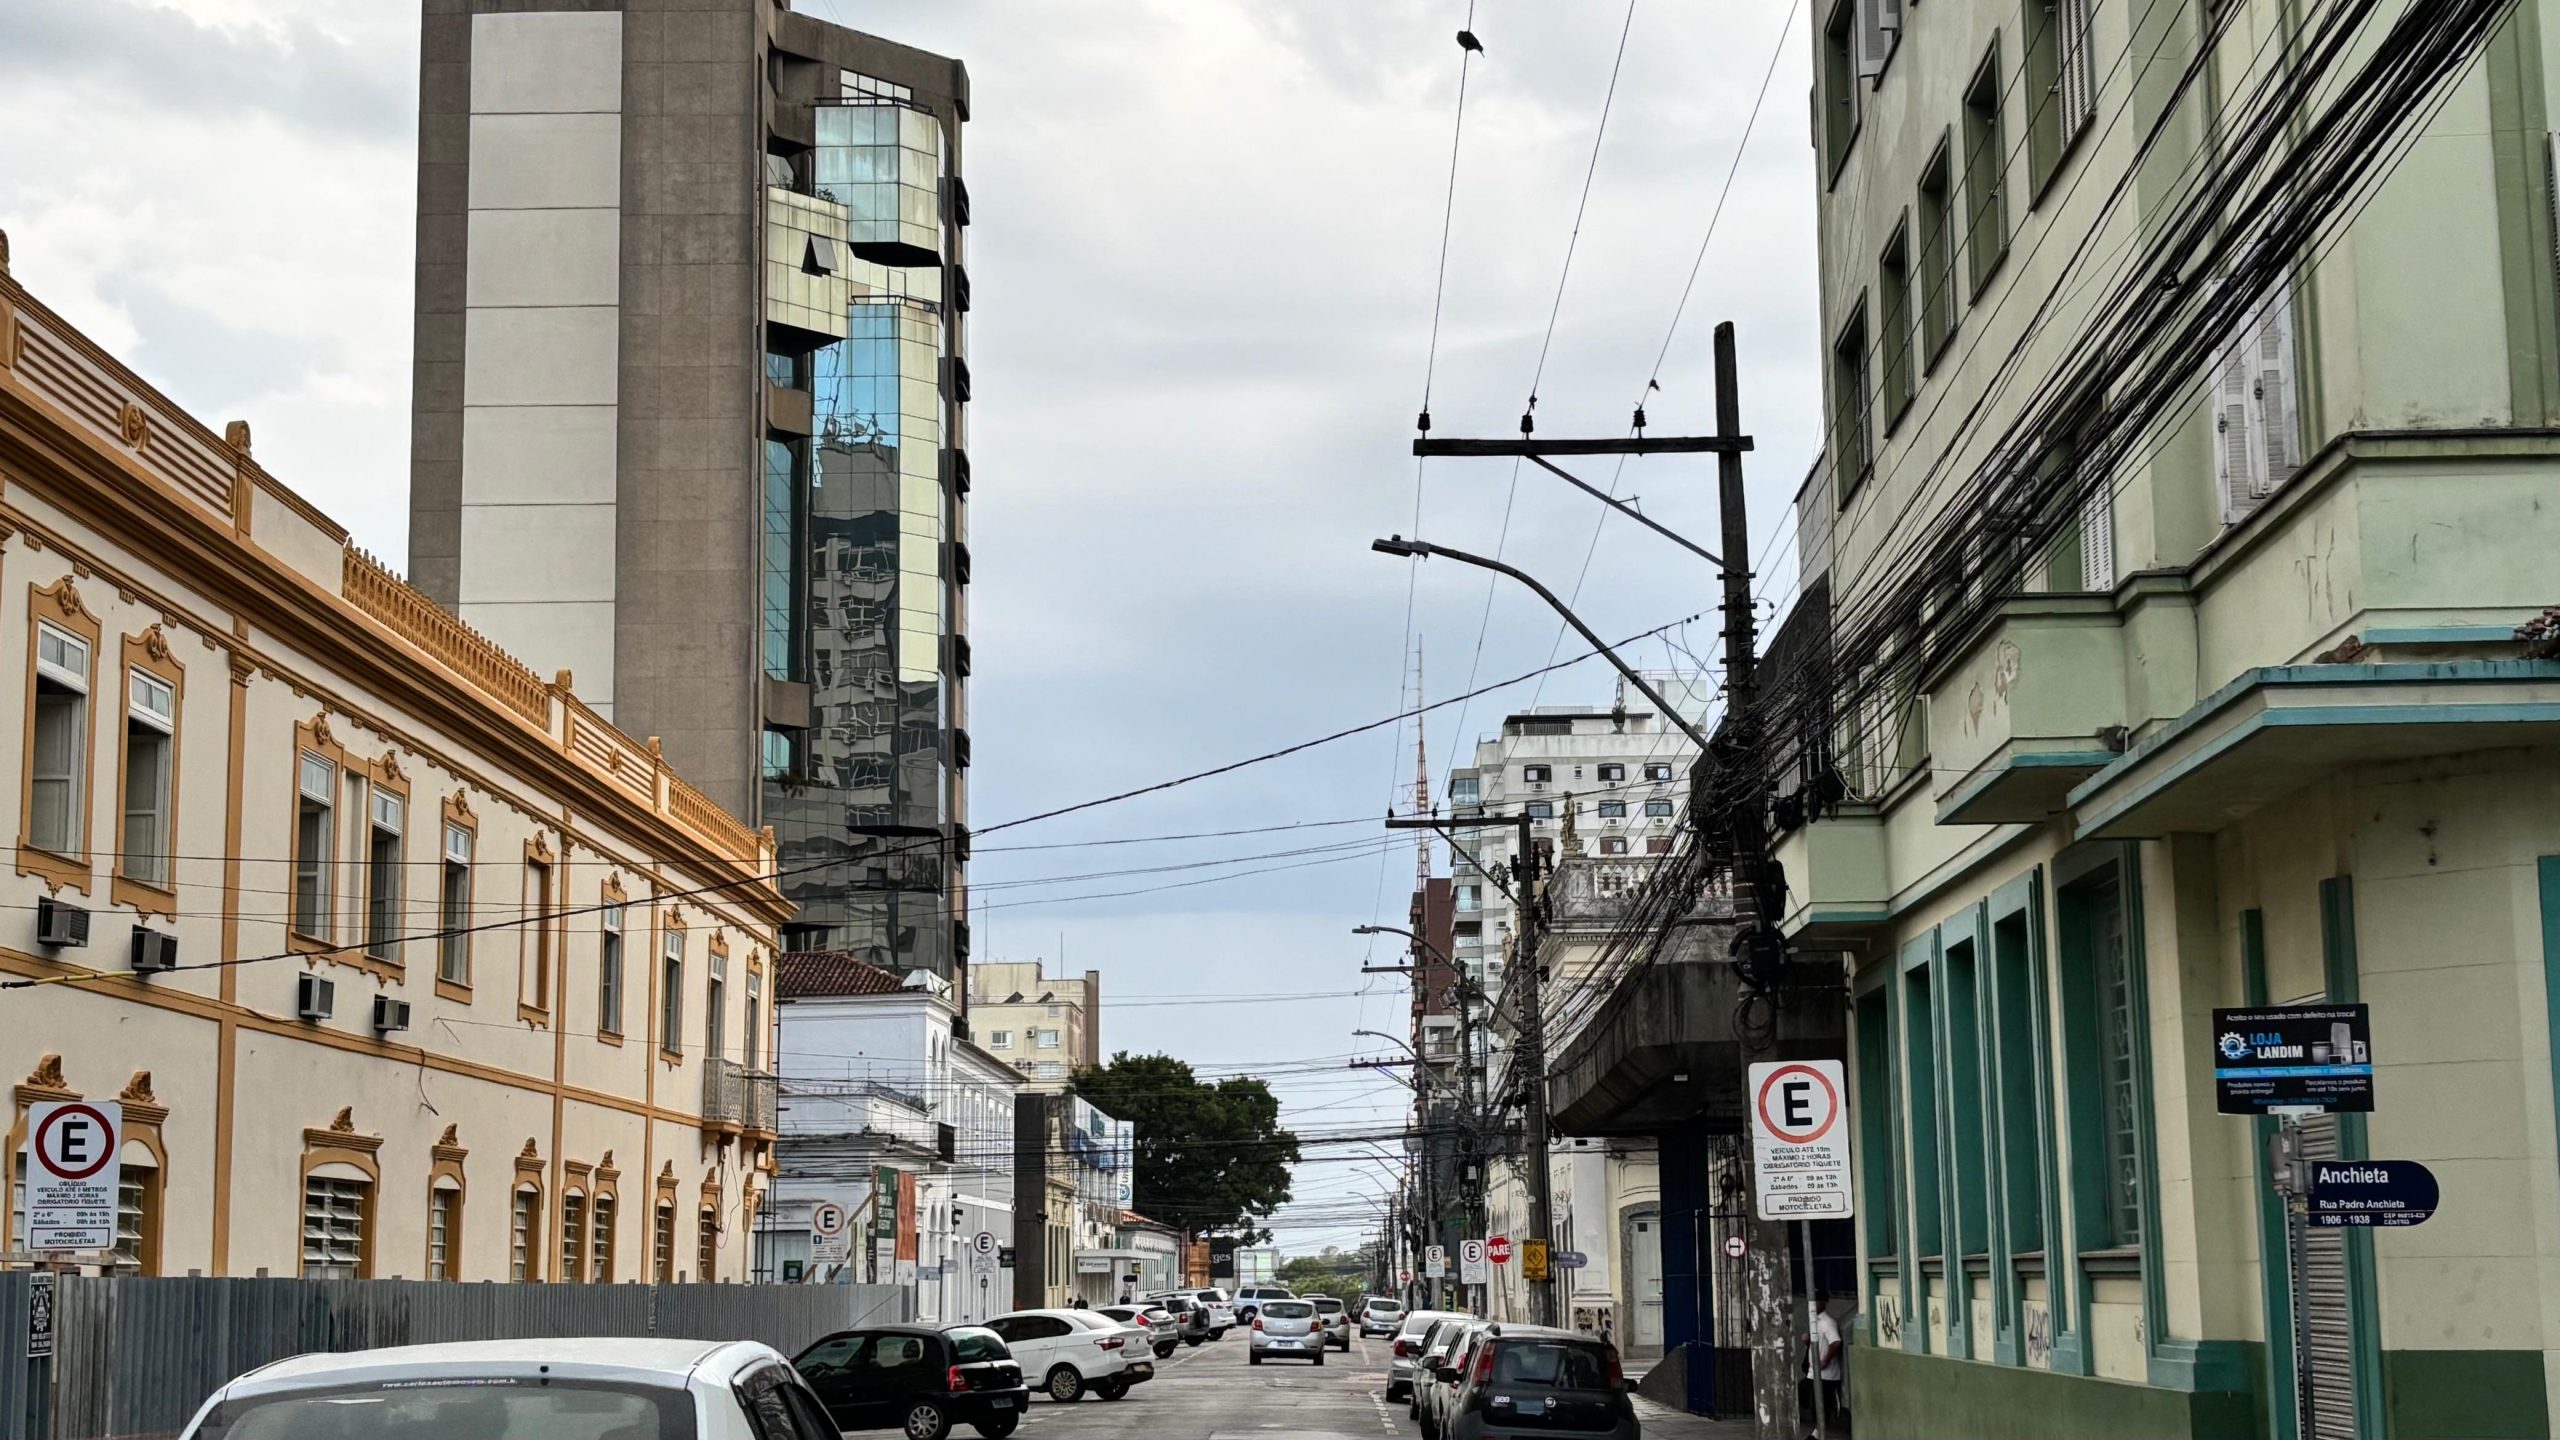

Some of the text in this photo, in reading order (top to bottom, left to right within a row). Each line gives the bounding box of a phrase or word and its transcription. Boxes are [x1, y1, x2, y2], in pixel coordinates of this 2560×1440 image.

[2302, 1011, 2326, 1019] defeito
[2250, 1032, 2282, 1046] LOJA
[2257, 1044, 2304, 1059] LANDIM
[1783, 1082, 1813, 1127] E
[61, 1122, 88, 1162] E
[2319, 1166, 2390, 1184] Anchieta
[2320, 1200, 2405, 1209] Rua Padre Anchieta
[824, 1210, 835, 1228] E
[2320, 1215, 2342, 1224] 1906
[2350, 1215, 2370, 1224] 1938
[980, 1236, 989, 1249] E
[1431, 1249, 1438, 1258] E
[1469, 1246, 1476, 1258] E
[1488, 1244, 1511, 1256] PARE
